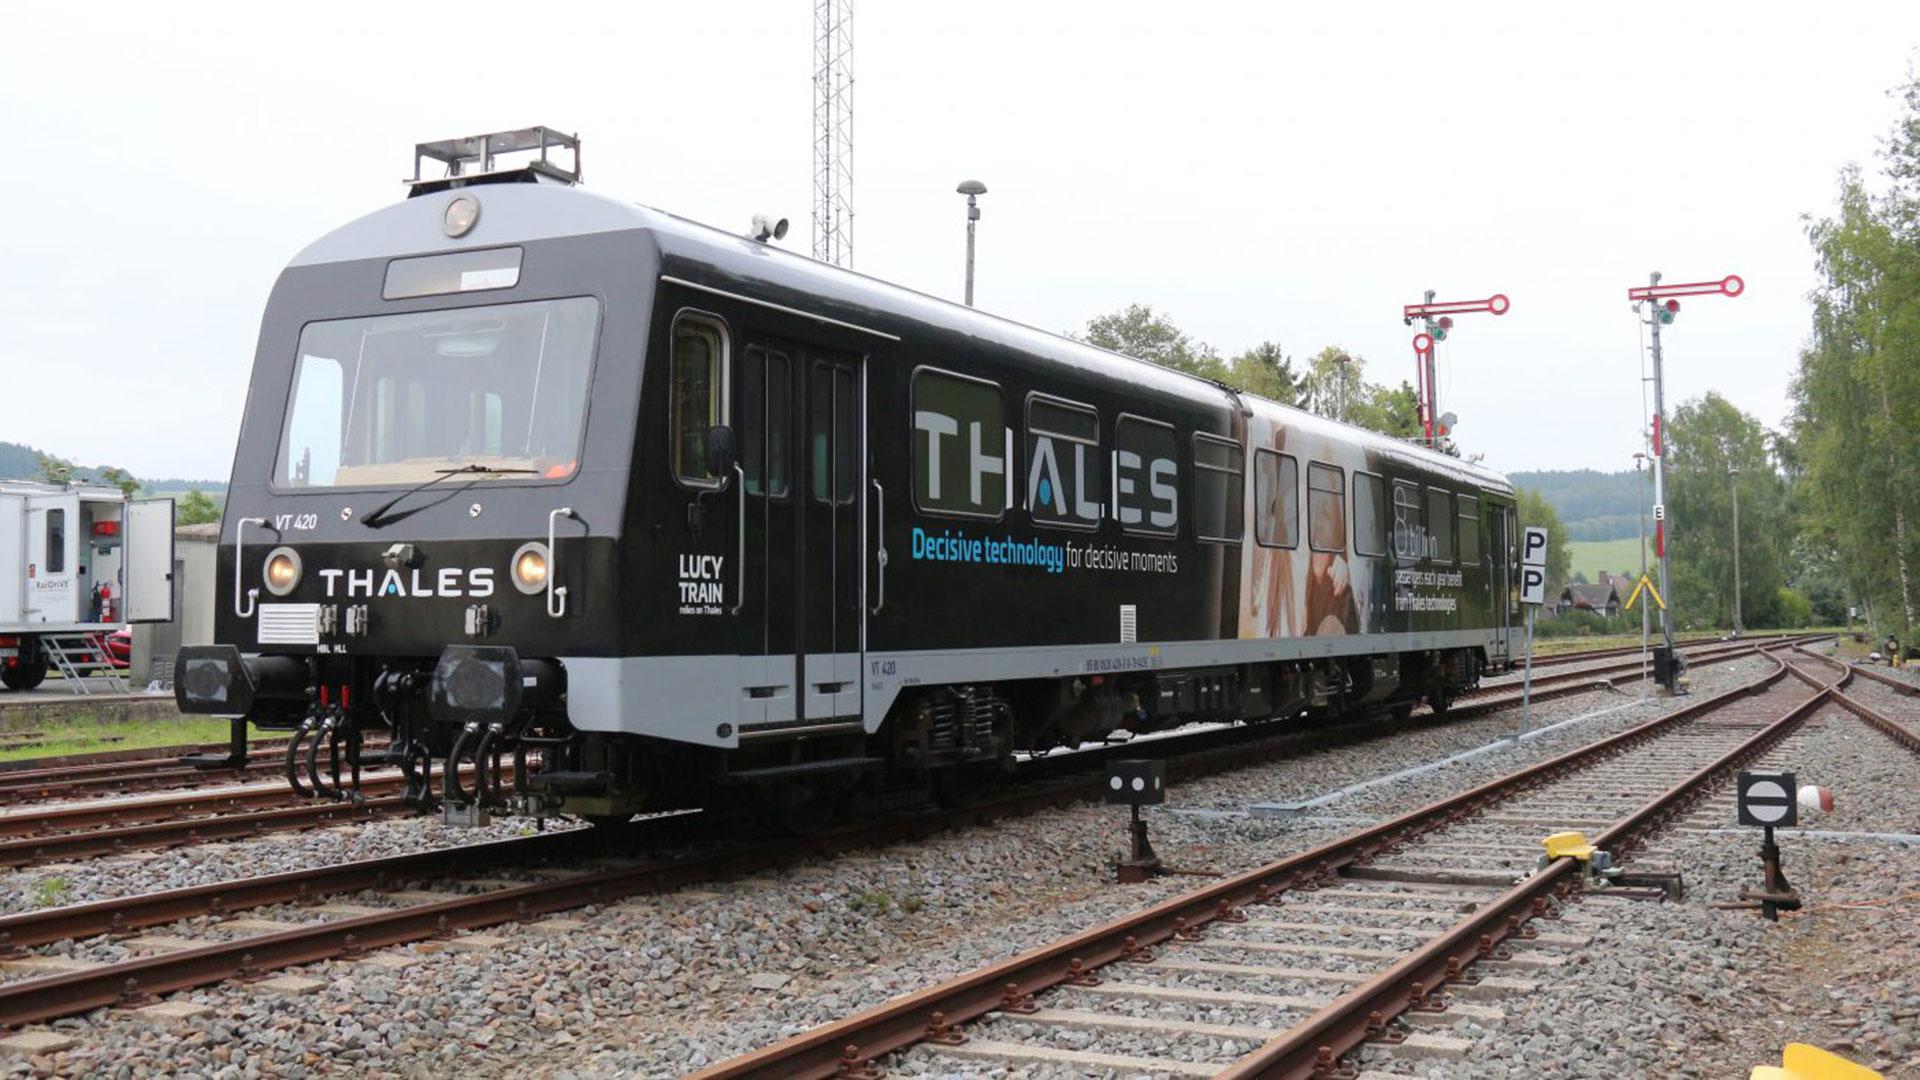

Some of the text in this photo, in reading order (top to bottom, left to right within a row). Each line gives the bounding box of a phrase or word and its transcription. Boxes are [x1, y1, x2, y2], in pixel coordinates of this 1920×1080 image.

[915, 411, 1177, 527] THALES
[276, 514, 317, 530] VT 420
[1656, 507, 1663, 518] E
[912, 527, 1178, 573] Decisive technology for decisive moments
[1525, 532, 1545, 559] P
[680, 554, 723, 579] LUCY
[319, 568, 494, 597] THALES
[679, 582, 723, 603] TRAIN
[1522, 570, 1542, 597] P
[882, 660, 895, 675] 420
